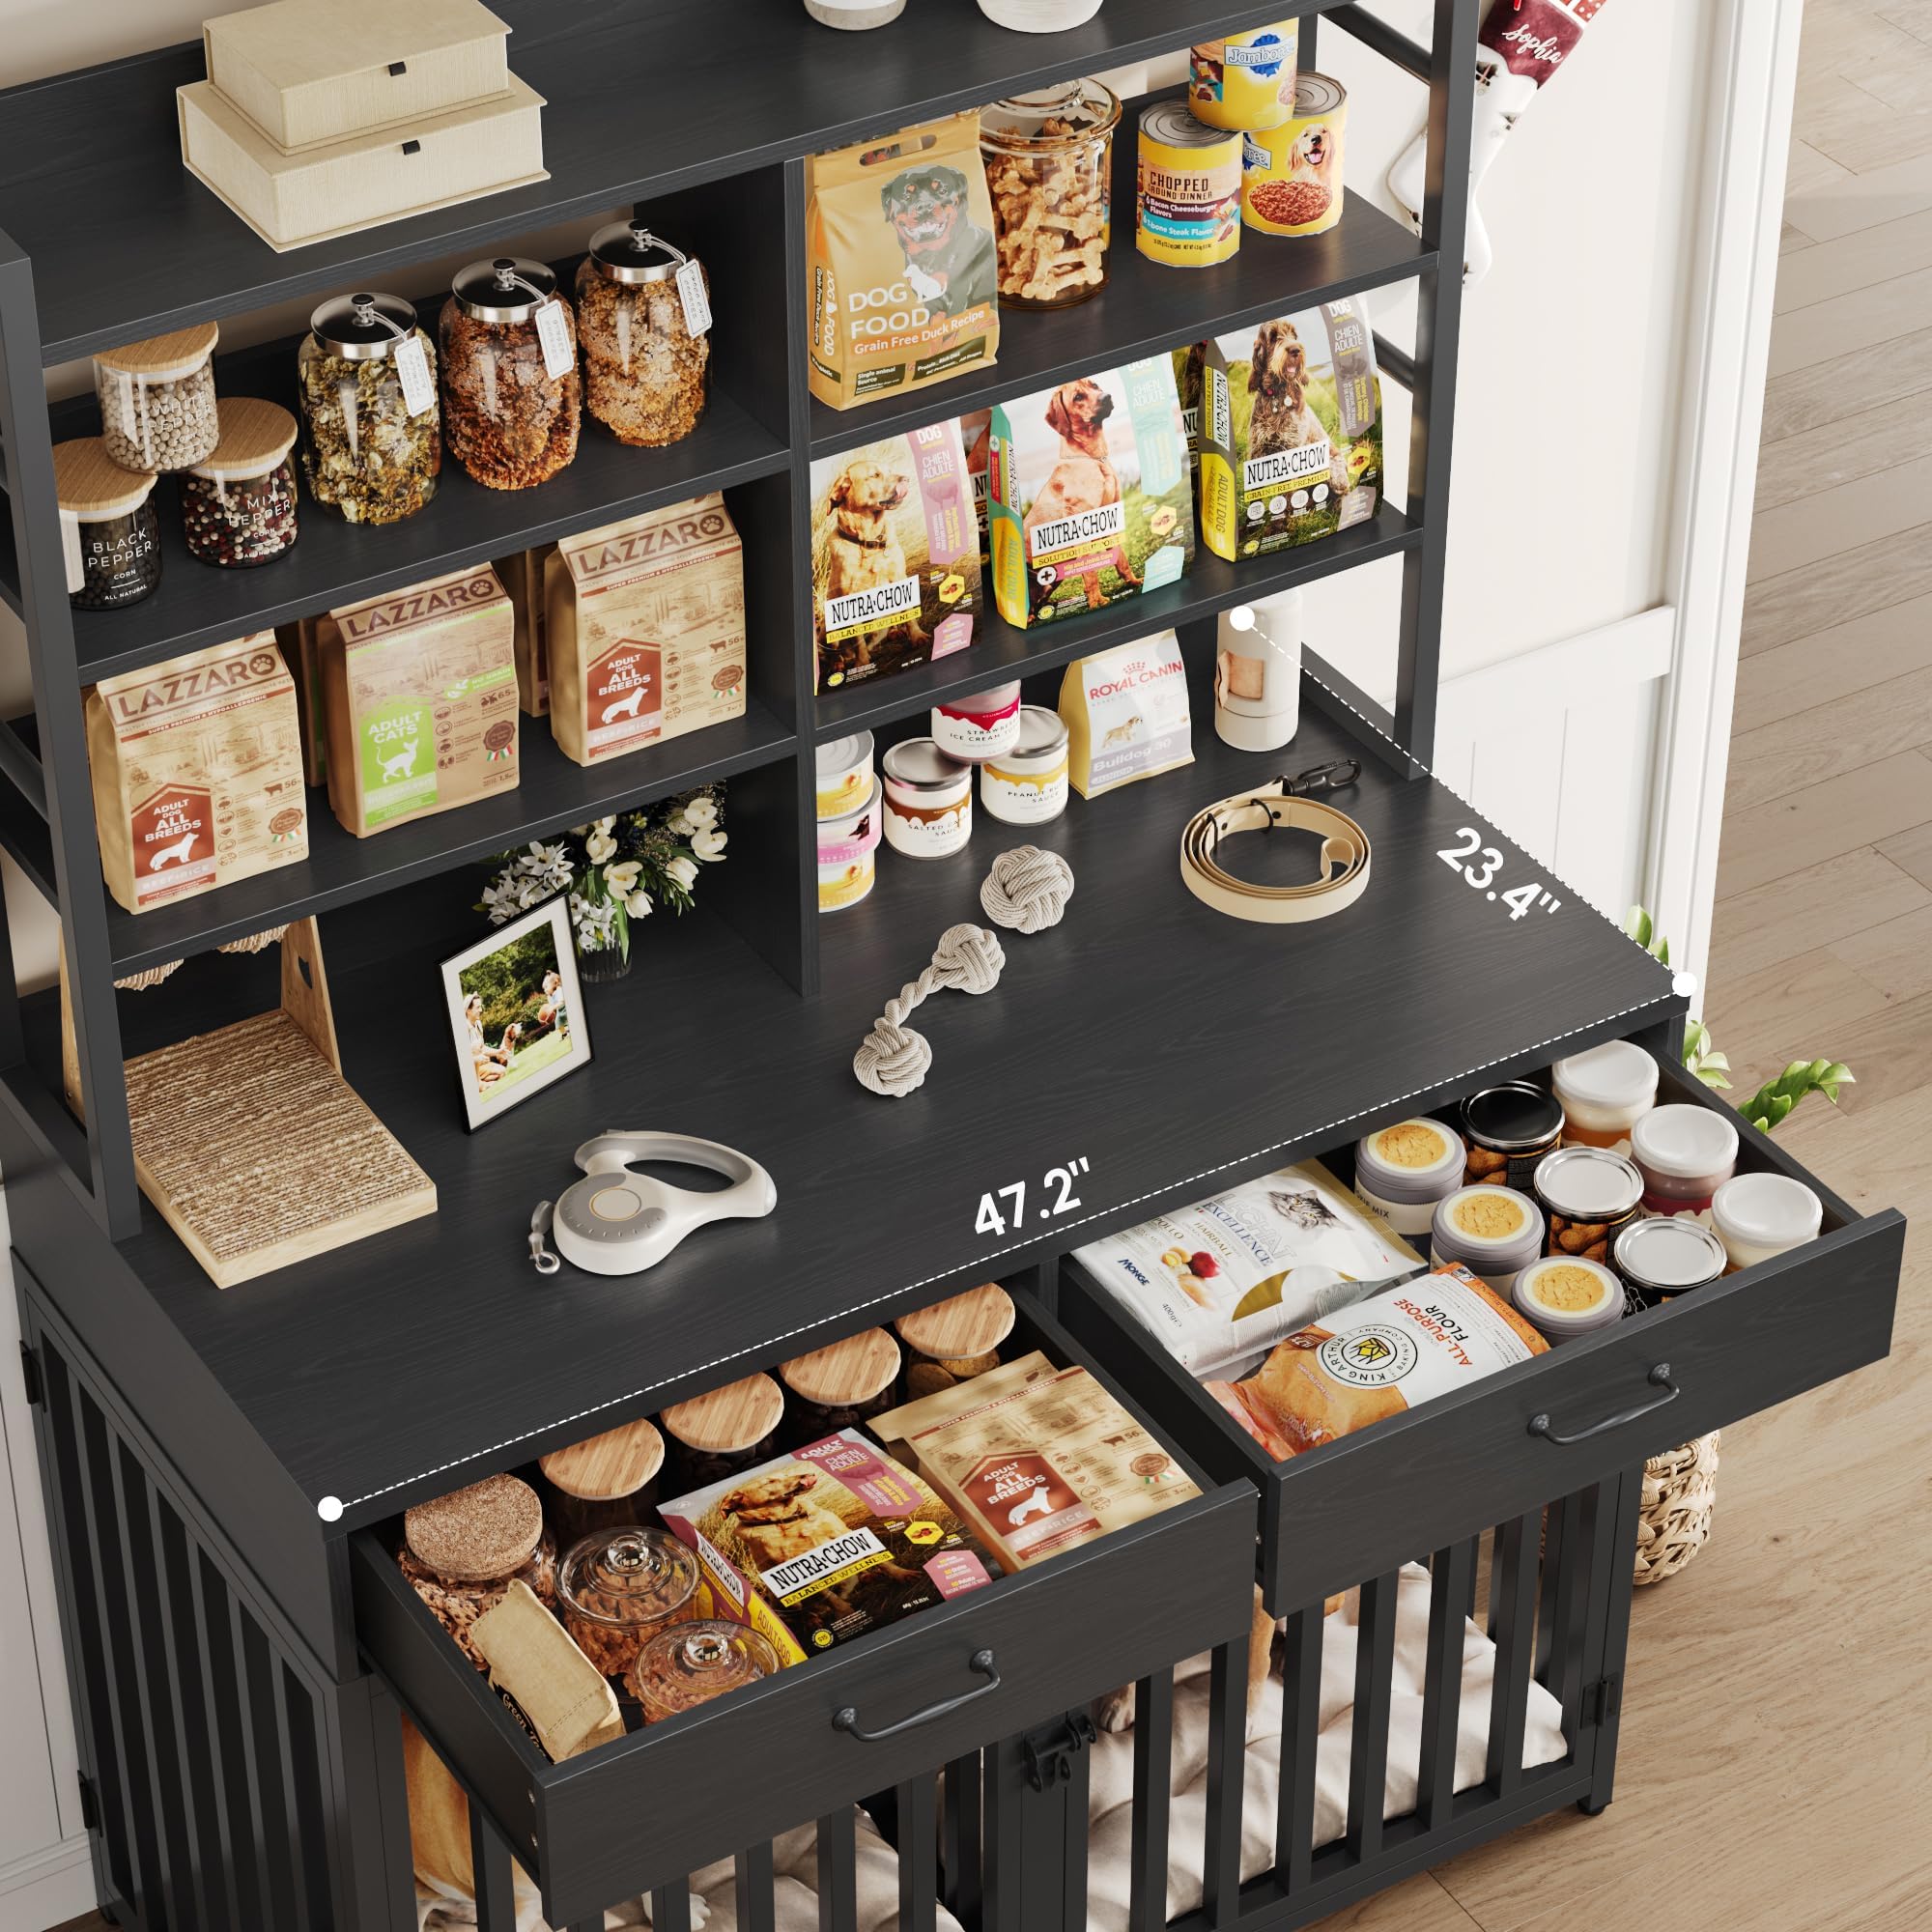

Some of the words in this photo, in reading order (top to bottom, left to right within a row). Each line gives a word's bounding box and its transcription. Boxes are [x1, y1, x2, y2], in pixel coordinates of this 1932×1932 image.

[1150, 171, 1209, 192] CHOPPED
[1150, 199, 1170, 212] Bacon
[1170, 202, 1217, 214] Cheeseburger
[1179, 189, 1212, 201] DINNER
[1150, 207, 1173, 219] Flavors
[1169, 225, 1191, 237] Steak
[849, 283, 907, 314] DOG
[1327, 298, 1352, 318] DOG
[850, 307, 930, 340] FOOD
[854, 338, 889, 355] Grain
[891, 332, 919, 349] Free
[922, 325, 950, 342] Duck
[951, 309, 985, 329] Recipe
[1334, 324, 1361, 342] CHIEN
[823, 316, 836, 356] FOOD
[1334, 334, 1364, 354] ADULTE
[152, 391, 205, 415] WHITE
[148, 405, 213, 431] PEPPER
[917, 425, 943, 445] DOG
[922, 450, 951, 469] CHIEN
[923, 461, 954, 480] ADULTE
[1217, 473, 1229, 508] ADULT
[1293, 471, 1329, 491] PREMIUM
[228, 501, 292, 526] PEPPER
[246, 494, 275, 510] MIX
[1215, 509, 1227, 533] DOG
[93, 527, 147, 554] BLACK
[579, 513, 725, 575] LAZZARO
[88, 540, 152, 568] PEPPER
[114, 569, 136, 581] CORN
[607, 582, 626, 591] SUPER
[627, 570, 656, 586] PREMIUM
[662, 553, 717, 575] HYPOALLERGENIC
[346, 579, 495, 638] LAZZARO
[828, 619, 875, 642] BALANCED
[875, 609, 921, 631] WELLNESS
[608, 653, 641, 669] ADULT
[615, 663, 635, 673] DOG
[117, 653, 276, 718] LAZZARO
[598, 673, 651, 696] BREEDS
[609, 668, 641, 686] ALL
[1090, 678, 1137, 700] ROYAL
[1138, 660, 1183, 683] CANIN
[148, 725, 170, 735] SUPER
[170, 715, 201, 730] PREMIUM
[208, 694, 268, 719] HYPOALLERGENIC
[368, 711, 422, 735] ADULT
[374, 723, 417, 744] CATS
[950, 732, 965, 742] ICE
[1093, 747, 1152, 774] Bulldog
[153, 798, 189, 815] ADULT
[162, 809, 182, 819] DOG
[145, 819, 202, 843] BREEDS
[156, 813, 190, 832] ALL
[907, 823, 945, 833] SALTED
[1372, 1205, 1390, 1220] MIX
[1202, 1202, 1272, 1268] EXCELLENCE
[1118, 1259, 1151, 1287] MONGE
[1393, 1298, 1474, 1367] ALL-PURPOSE
[1425, 1304, 1469, 1343] FLOUR
[1358, 1327, 1405, 1344] COMPANY
[1327, 1337, 1349, 1376] ARTHUR
[1397, 1341, 1410, 1372] BAKING
[1348, 1370, 1386, 1381] KING
[939, 1416, 960, 1430] SUPER
[960, 1404, 992, 1421] PREMIUM
[824, 1448, 862, 1466] CHIEN
[830, 1452, 869, 1473] ADULTE
[983, 1461, 1020, 1482] ADULT
[995, 1470, 1015, 1484] DOG
[987, 1474, 1047, 1506] BREEDS
[994, 1474, 1030, 1493] ALL
[784, 1576, 838, 1605] BALANCED
[838, 1552, 892, 1579] WELLNESS
[756, 1607, 778, 1643] ADULT
[775, 1637, 792, 1665] DOG
[502, 1692, 527, 1731] Green
